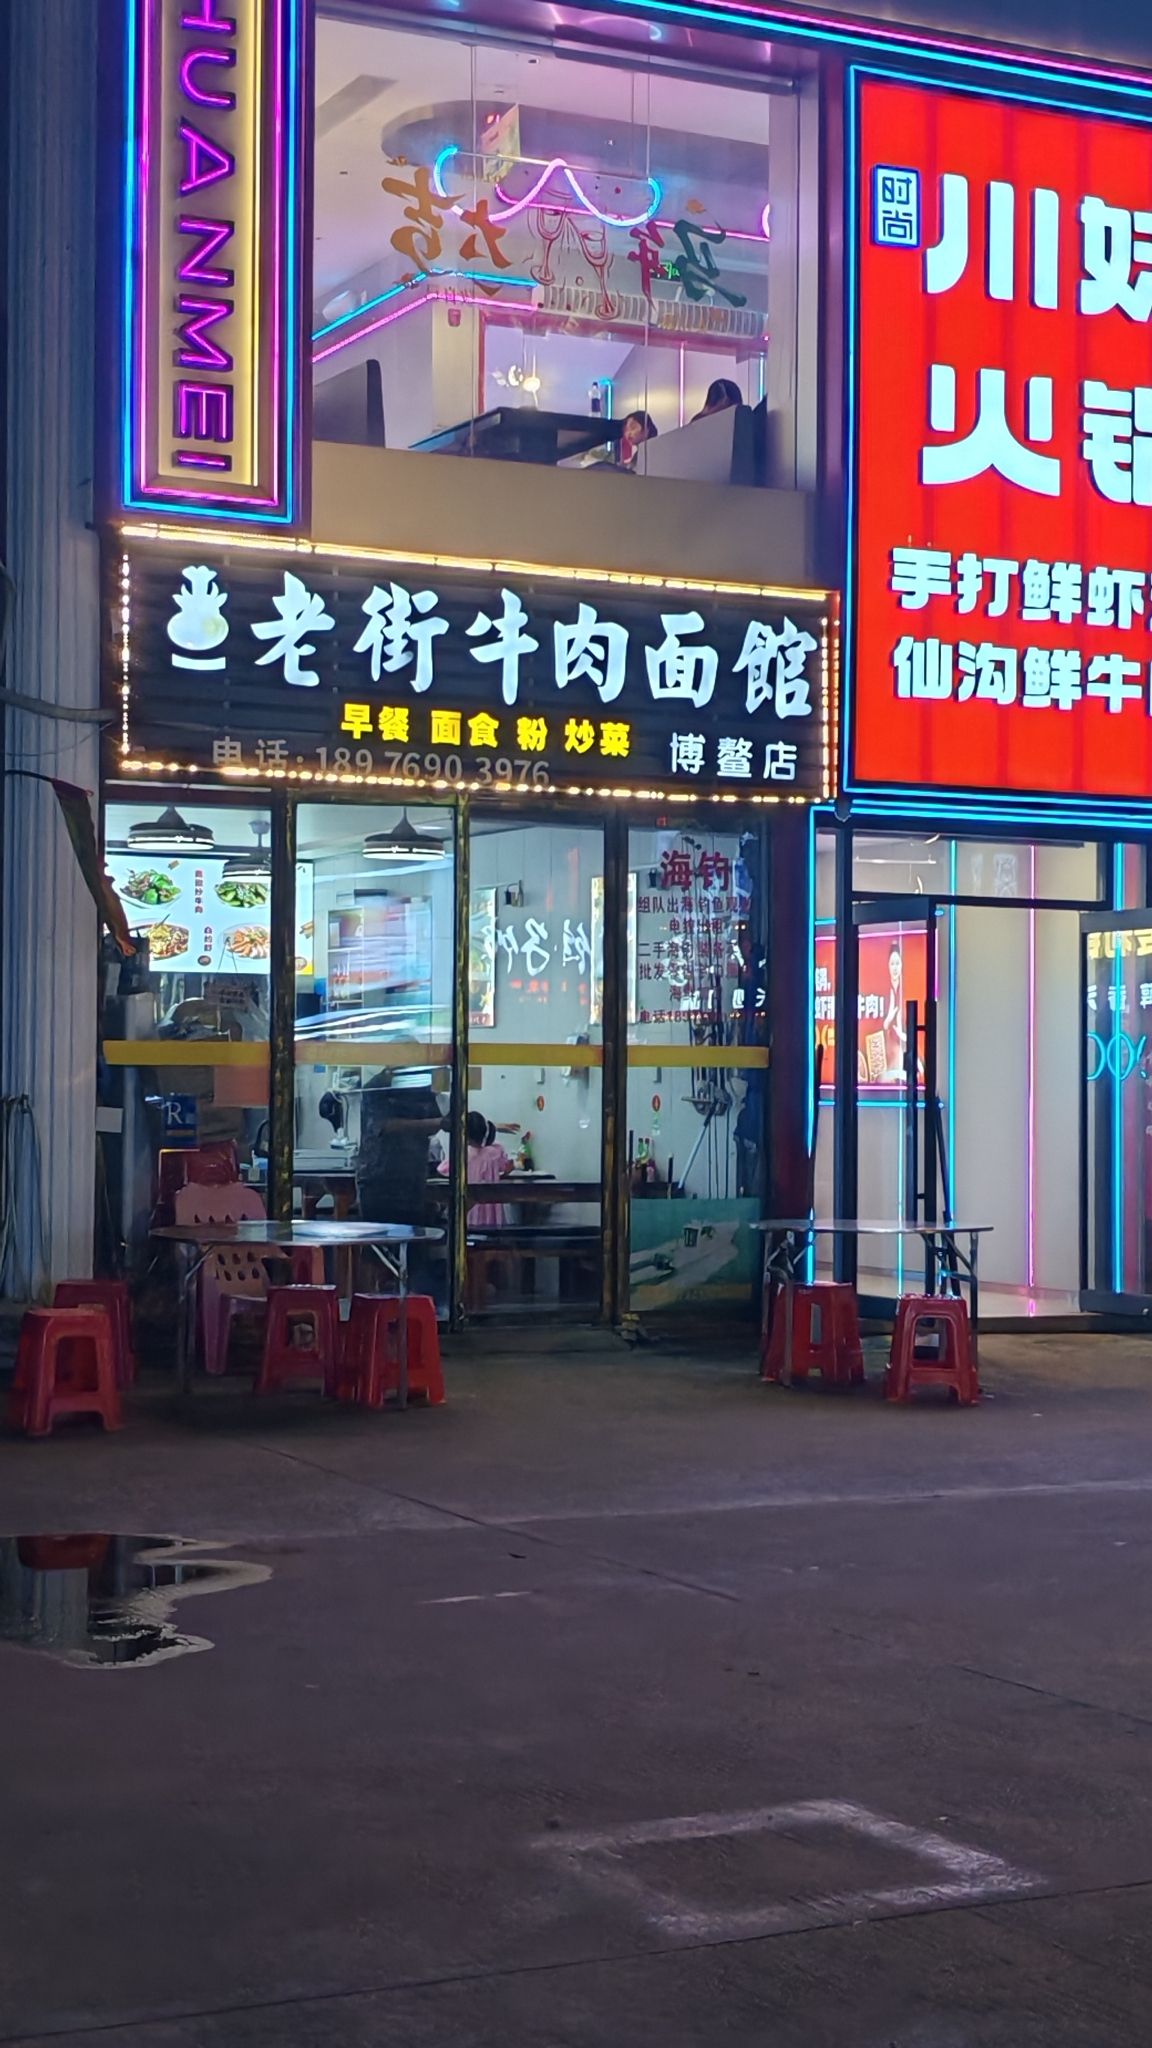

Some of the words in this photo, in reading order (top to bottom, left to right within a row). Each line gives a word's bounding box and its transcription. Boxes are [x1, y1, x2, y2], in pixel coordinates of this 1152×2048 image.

[880, 175, 914, 242] 时尚
[889, 547, 1152, 632] 手打鲜虾
[250, 571, 817, 719] 老街牛肉面館
[892, 635, 1152, 715] 仙沟鲜牛
[340, 703, 410, 743] 早餐
[430, 710, 500, 750] 面食
[516, 717, 548, 752] 粉
[564, 722, 631, 758] 炒菜
[669, 733, 798, 783] 博鳌店
[315, 746, 373, 774] 189
[384, 751, 463, 782] 7690
[474, 757, 551, 786] 3976
[660, 849, 732, 892] 海钓
